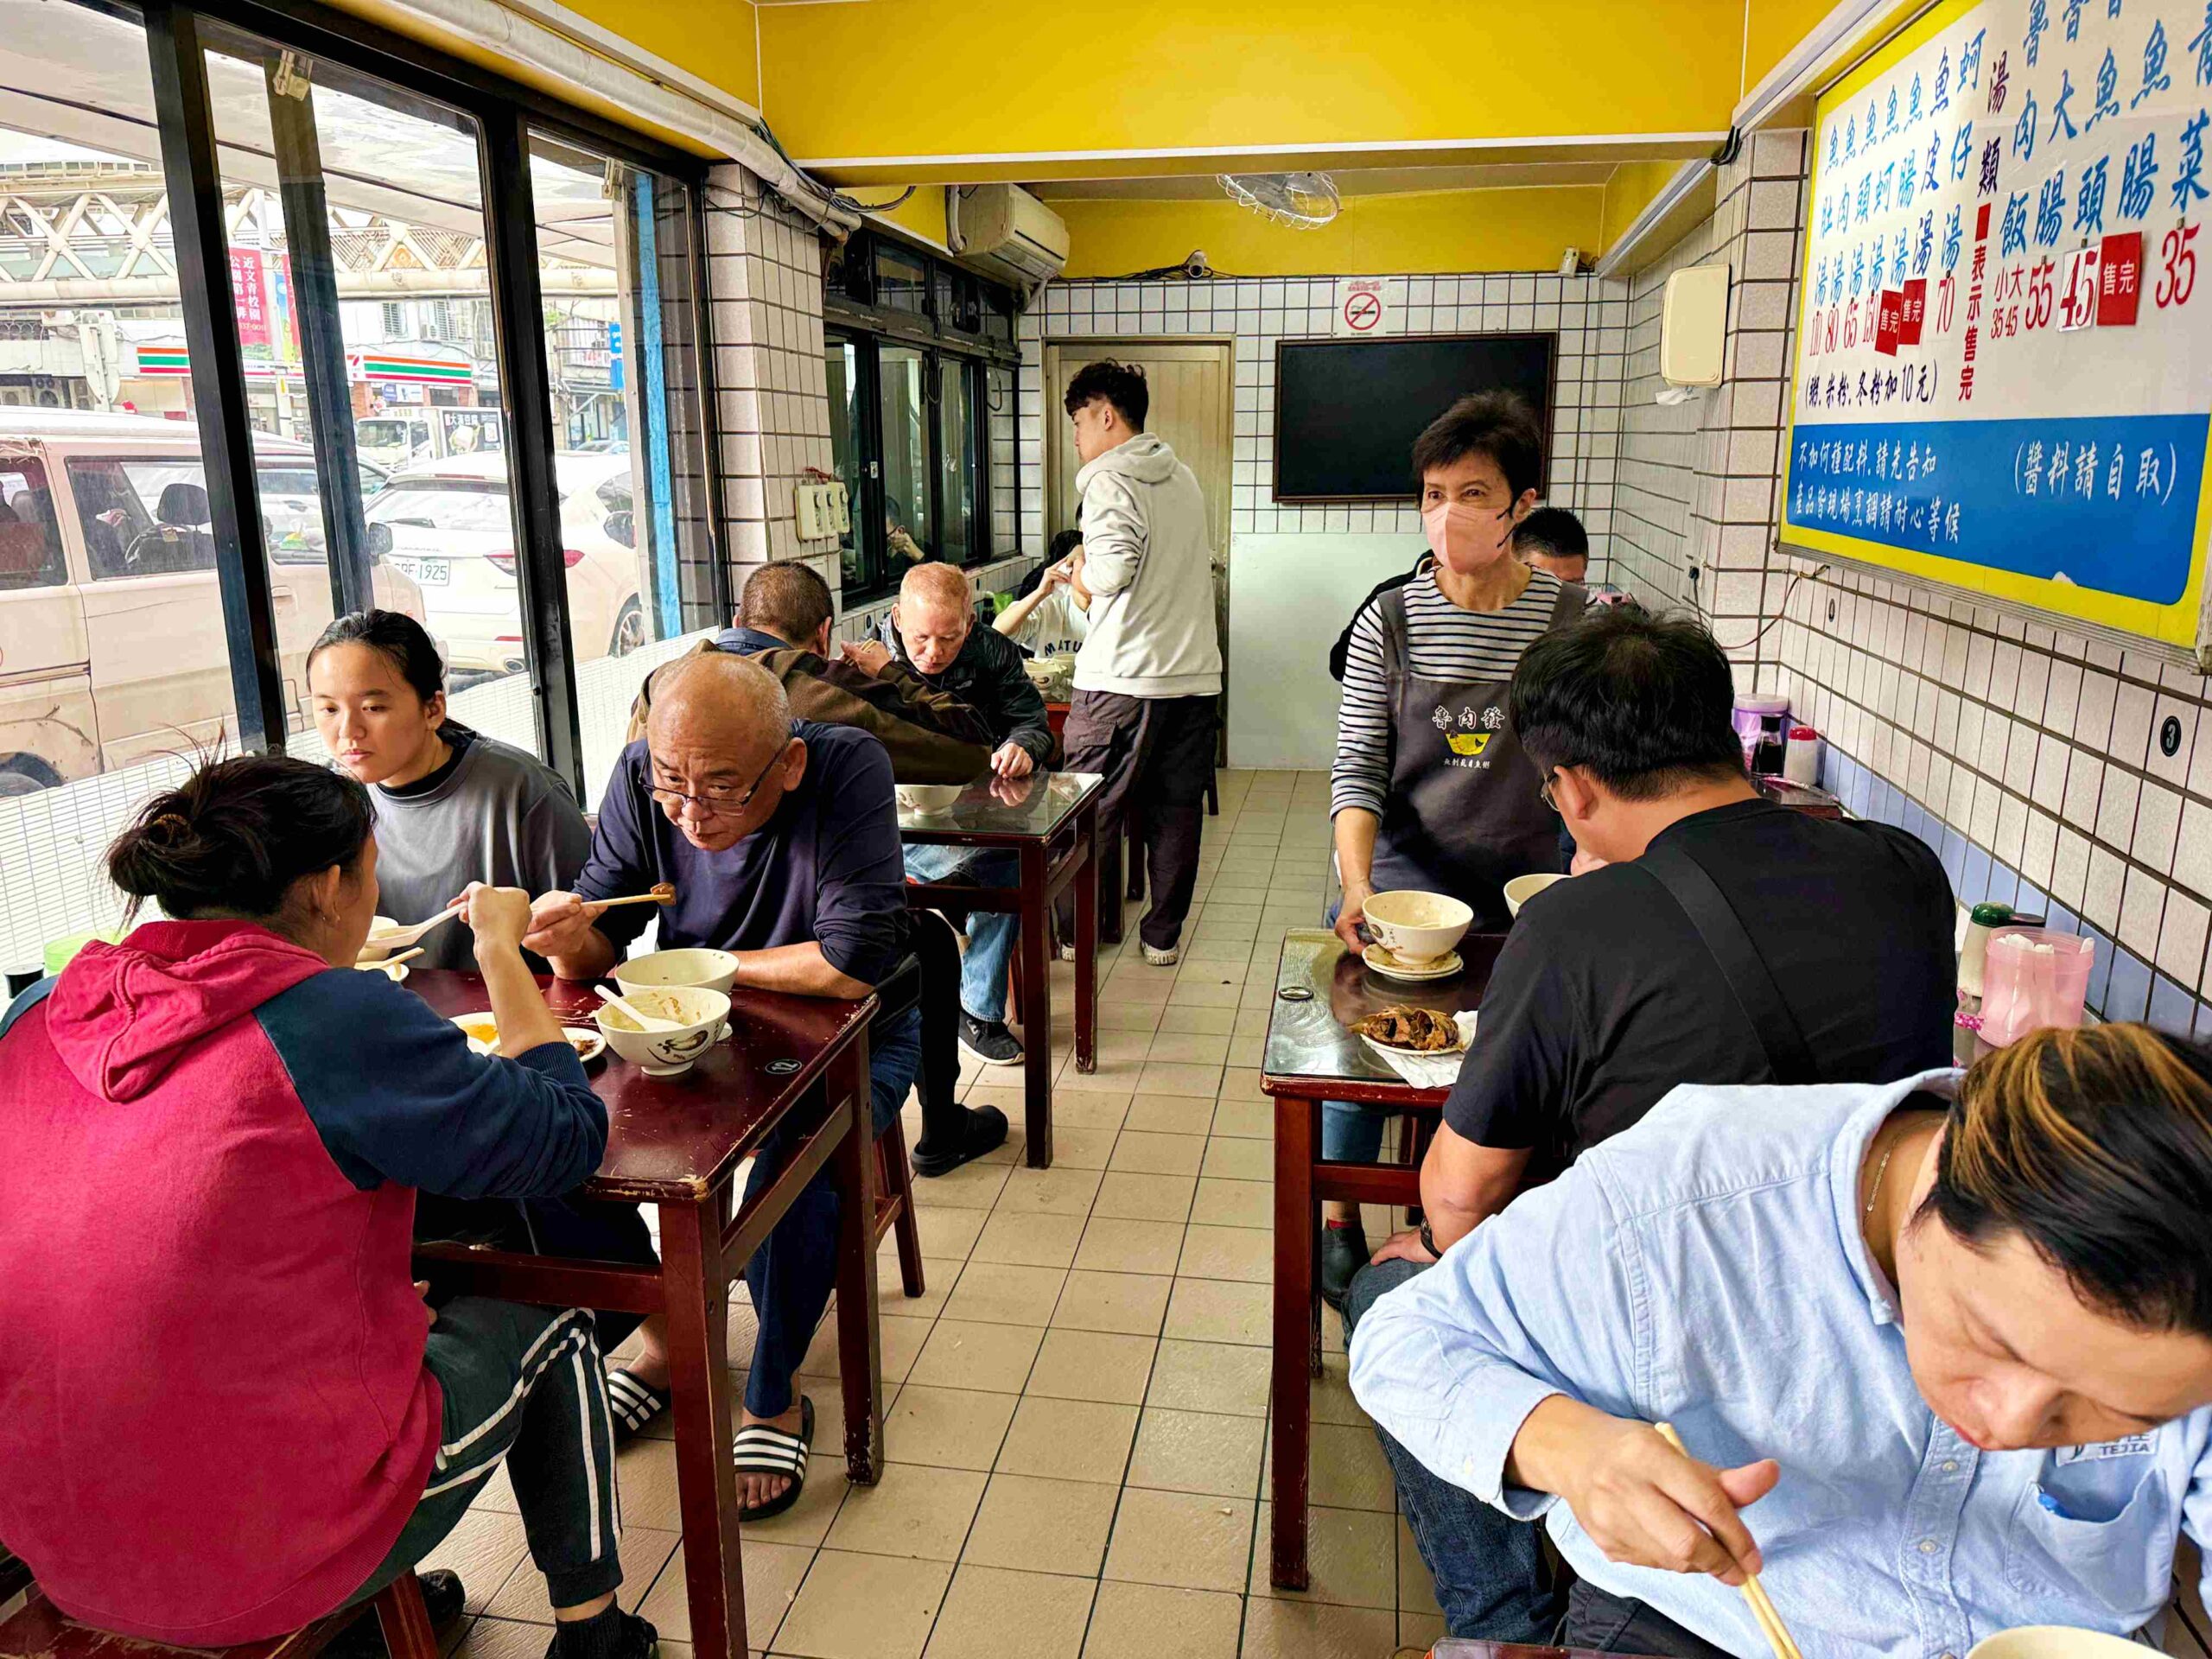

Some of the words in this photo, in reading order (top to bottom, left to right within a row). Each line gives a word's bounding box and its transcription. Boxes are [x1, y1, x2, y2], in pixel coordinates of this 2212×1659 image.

[1941, 27, 1986, 270] 蚵仔湯
[1977, 49, 2011, 200] 湯類
[2073, 0, 2121, 239] 魚頭
[1868, 84, 1899, 292] 魚蚵湯
[1890, 71, 1923, 289] 魚腸湯
[1912, 46, 1949, 276] 魚皮湯
[1829, 113, 1856, 305] 魚肉湯
[1848, 99, 1877, 297] 魚頭湯
[2024, 259, 2056, 330] 55
[2060, 250, 2100, 329] 45
[2102, 260, 2135, 296] 售完
[2157, 221, 2202, 308] 35
[1809, 311, 1822, 357] 110
[1825, 308, 1839, 354] 80
[1843, 302, 1859, 349] 65
[1879, 308, 1900, 334] 售完
[1902, 299, 1923, 322] 售完
[1936, 276, 1955, 334] 70
[1958, 244, 1987, 402] 表示售完
[1990, 307, 2005, 340] 35
[2005, 305, 2018, 337] 45
[395, 563, 448, 582] F-1925
[1432, 704, 1506, 730] 魯肉發
[2165, 724, 2176, 748] 3
[2099, 1444, 2150, 1455] TEJIA
